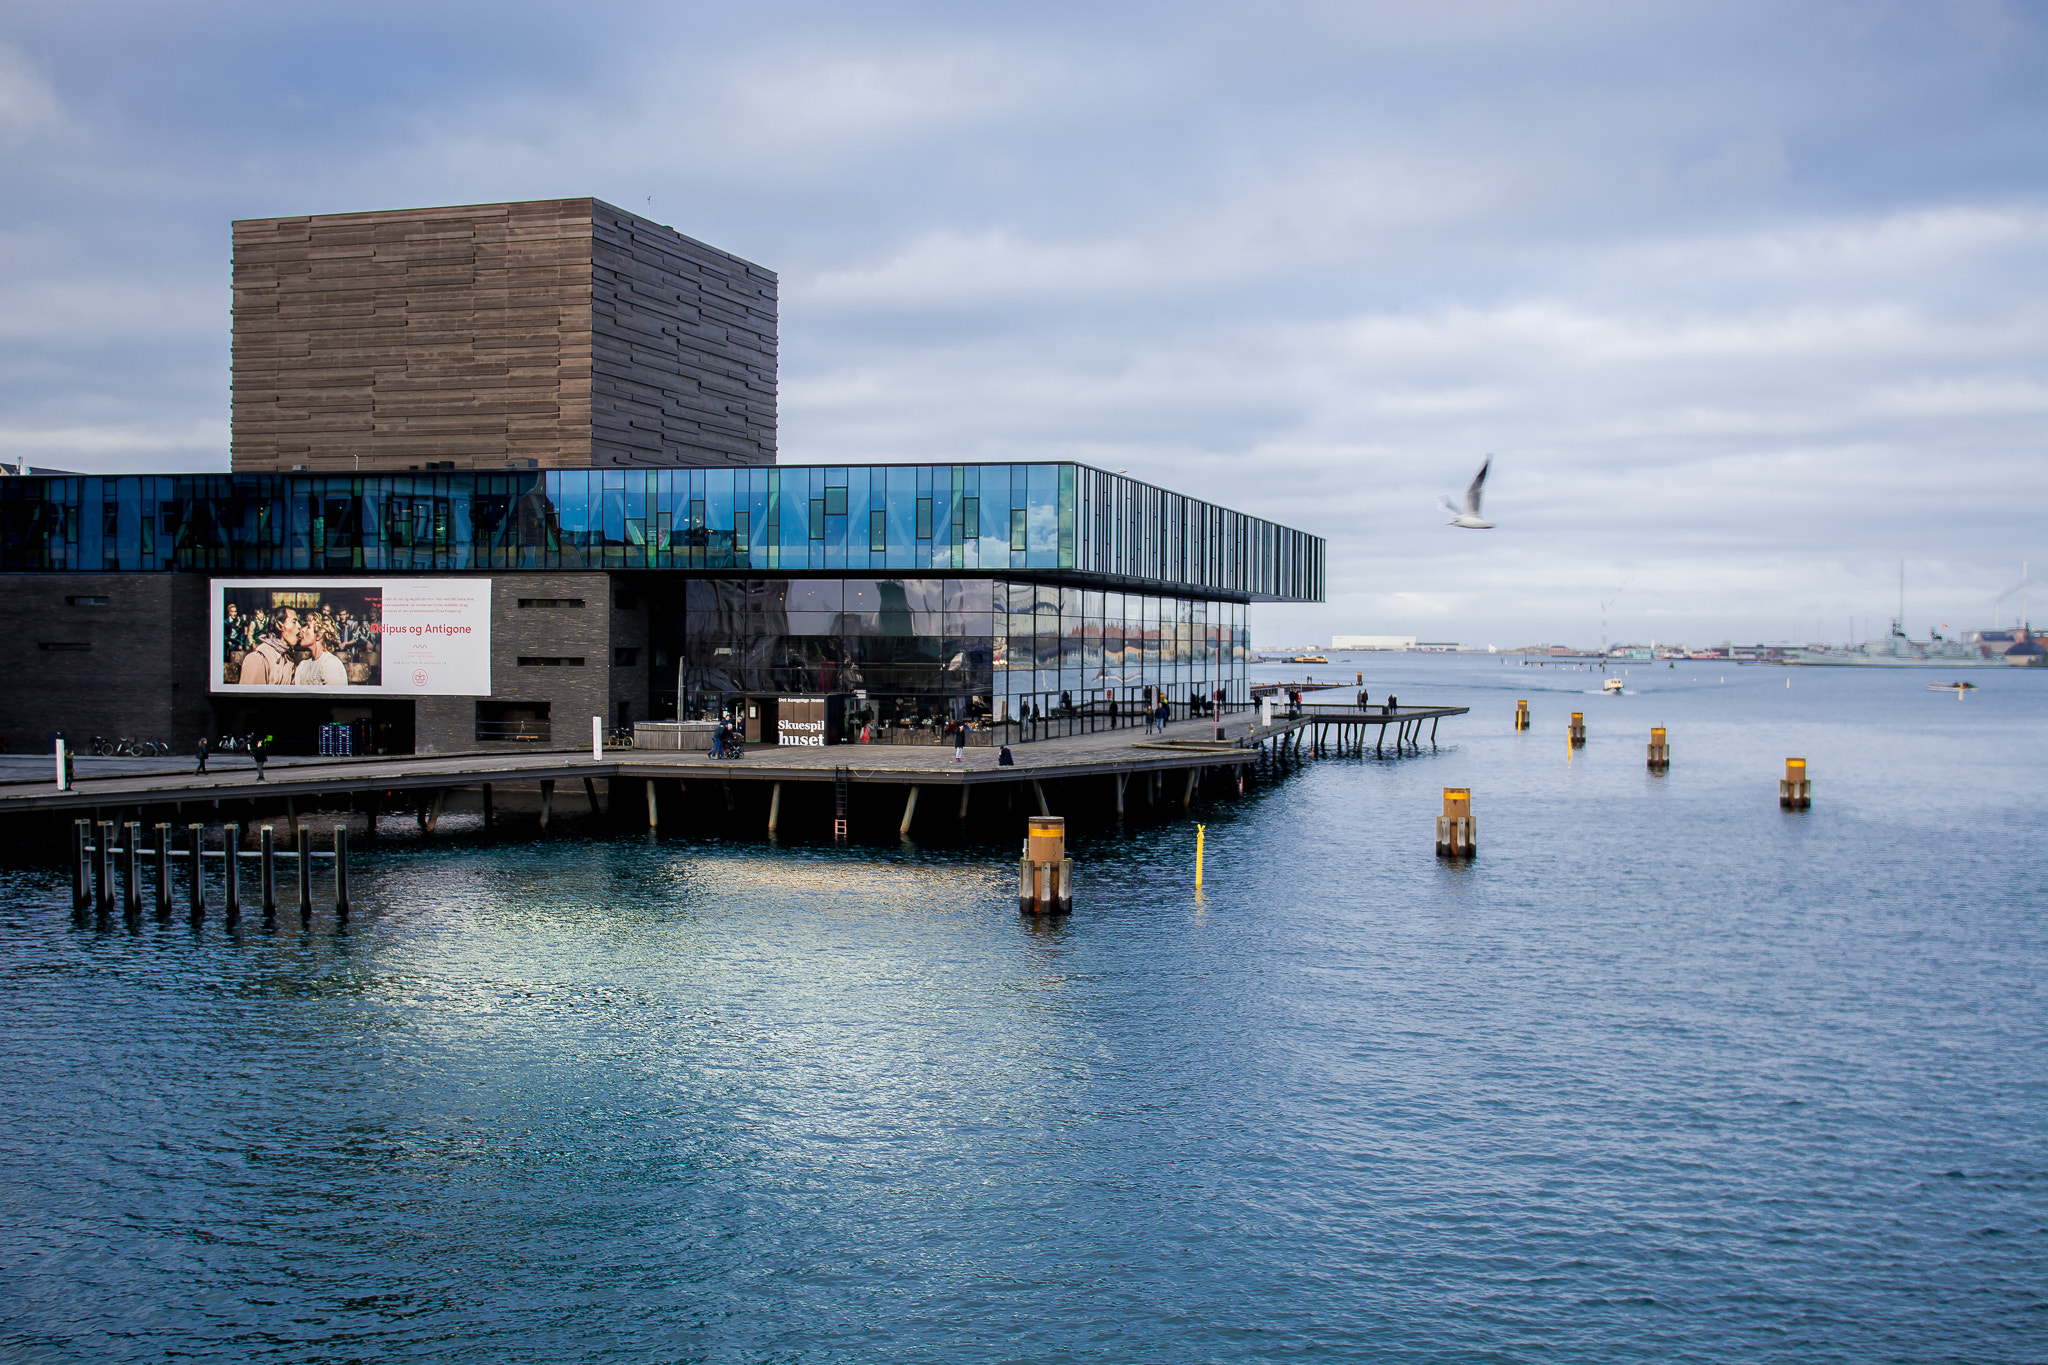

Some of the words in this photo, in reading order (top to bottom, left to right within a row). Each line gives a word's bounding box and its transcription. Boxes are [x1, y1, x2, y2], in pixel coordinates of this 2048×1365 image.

[370, 623, 407, 636] Ødipus
[409, 627, 422, 636] og
[425, 624, 471, 636] Antigone
[778, 720, 824, 732] Skuespil
[778, 731, 824, 746] huset
